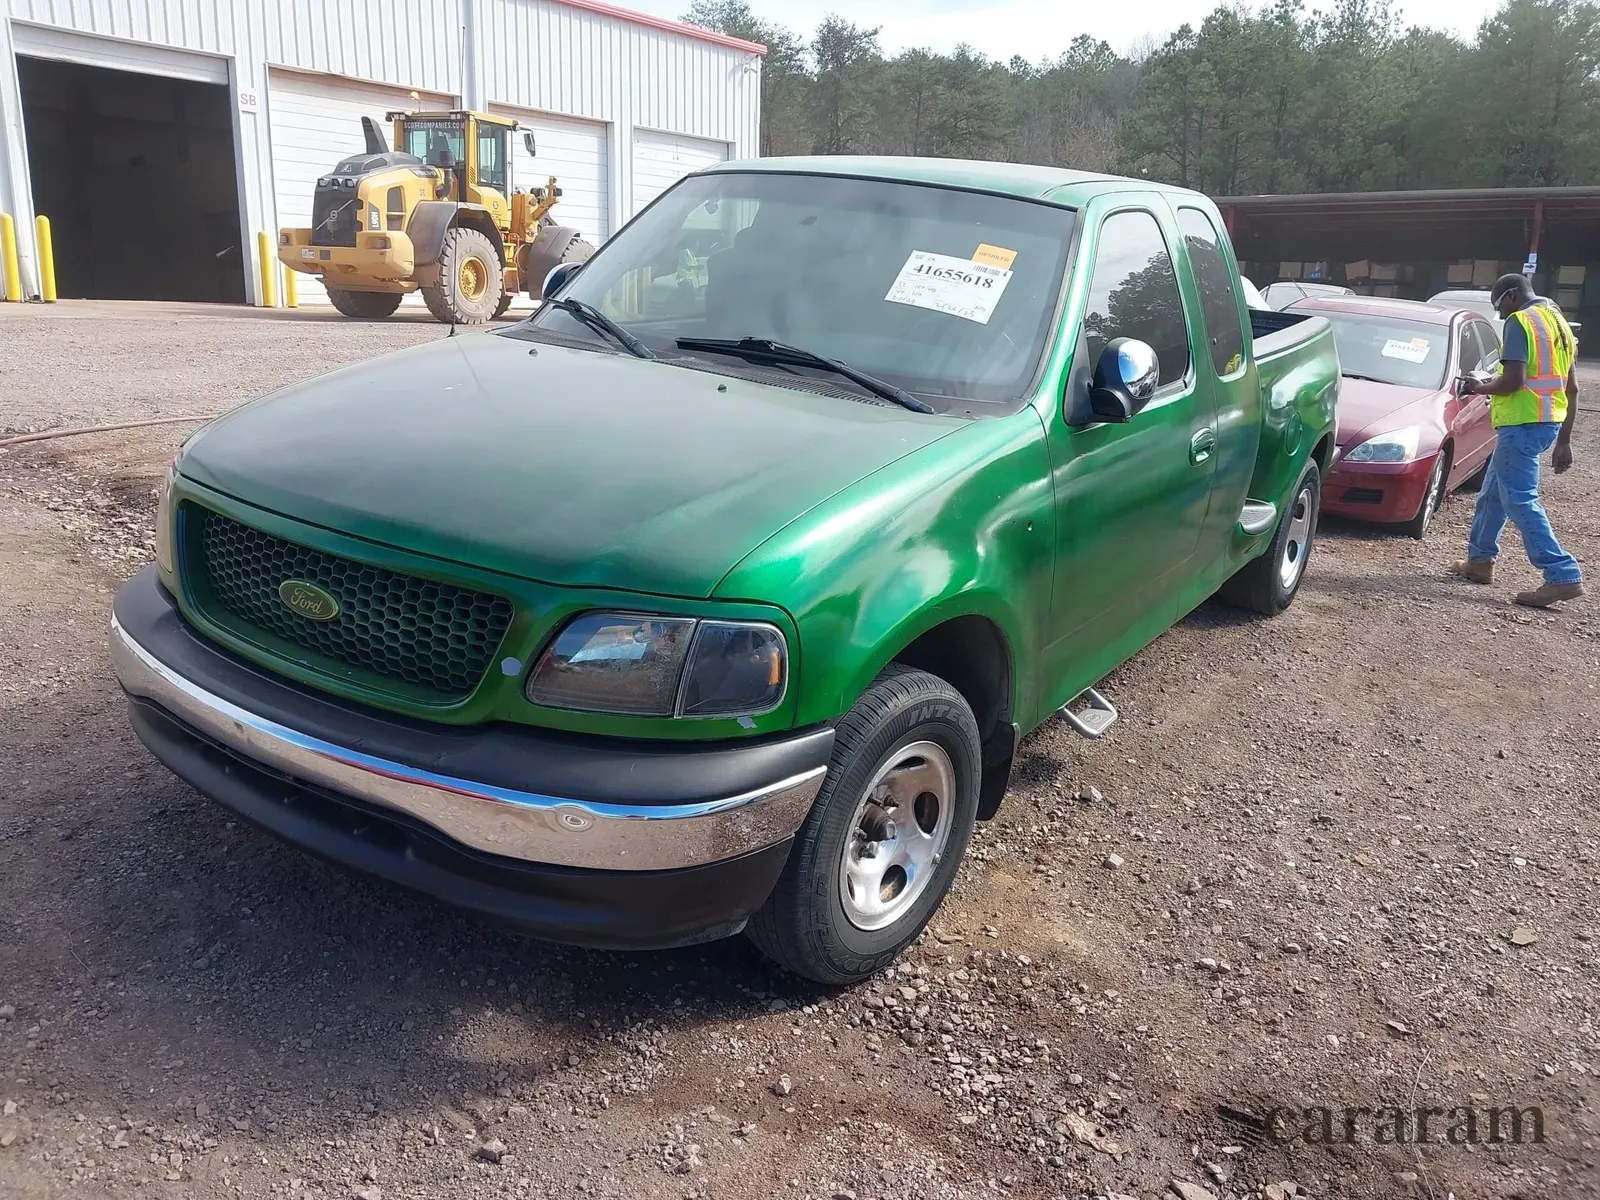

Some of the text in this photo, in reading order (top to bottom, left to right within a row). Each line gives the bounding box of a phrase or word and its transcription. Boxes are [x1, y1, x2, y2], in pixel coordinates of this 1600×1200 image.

[240, 93, 257, 106] SB
[978, 251, 1010, 262] DETAILED
[913, 264, 994, 289] 41655618
[291, 587, 322, 613] Ford
